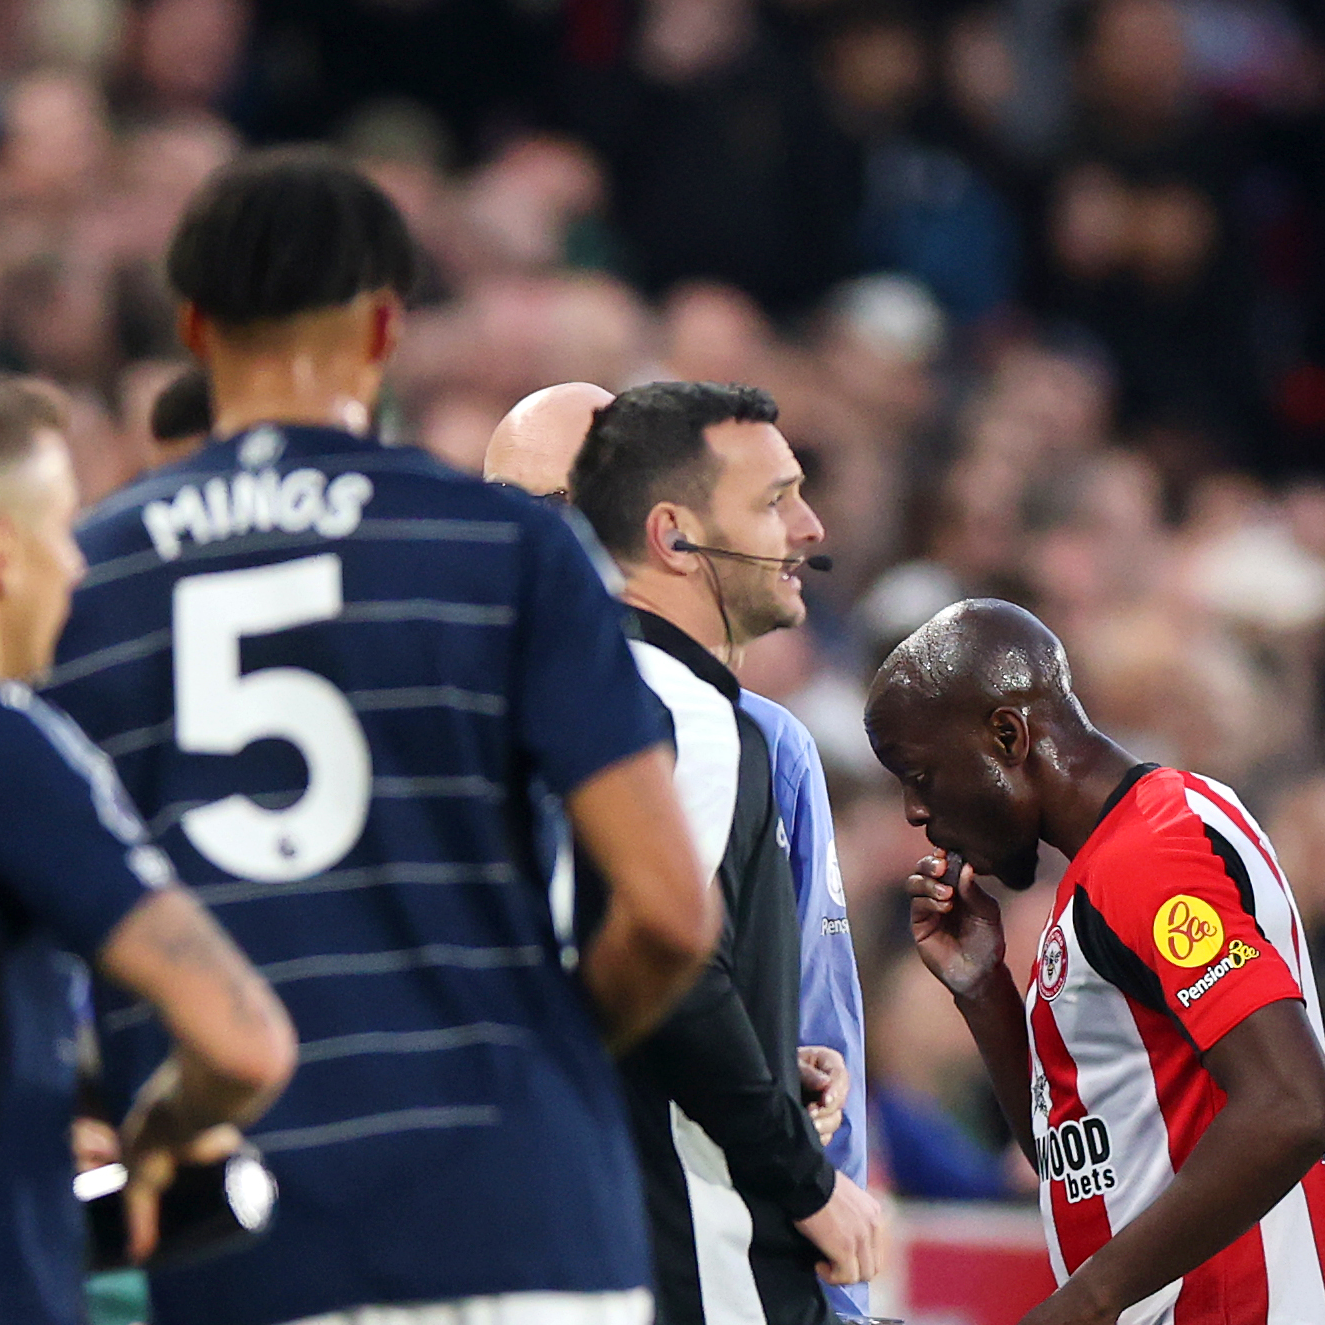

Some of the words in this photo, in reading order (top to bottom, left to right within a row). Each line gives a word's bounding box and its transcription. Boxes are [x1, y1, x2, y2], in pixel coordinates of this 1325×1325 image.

[142, 467, 374, 561] MINGS
[172, 552, 375, 882] 5
[1066, 1168, 1116, 1200] bets
